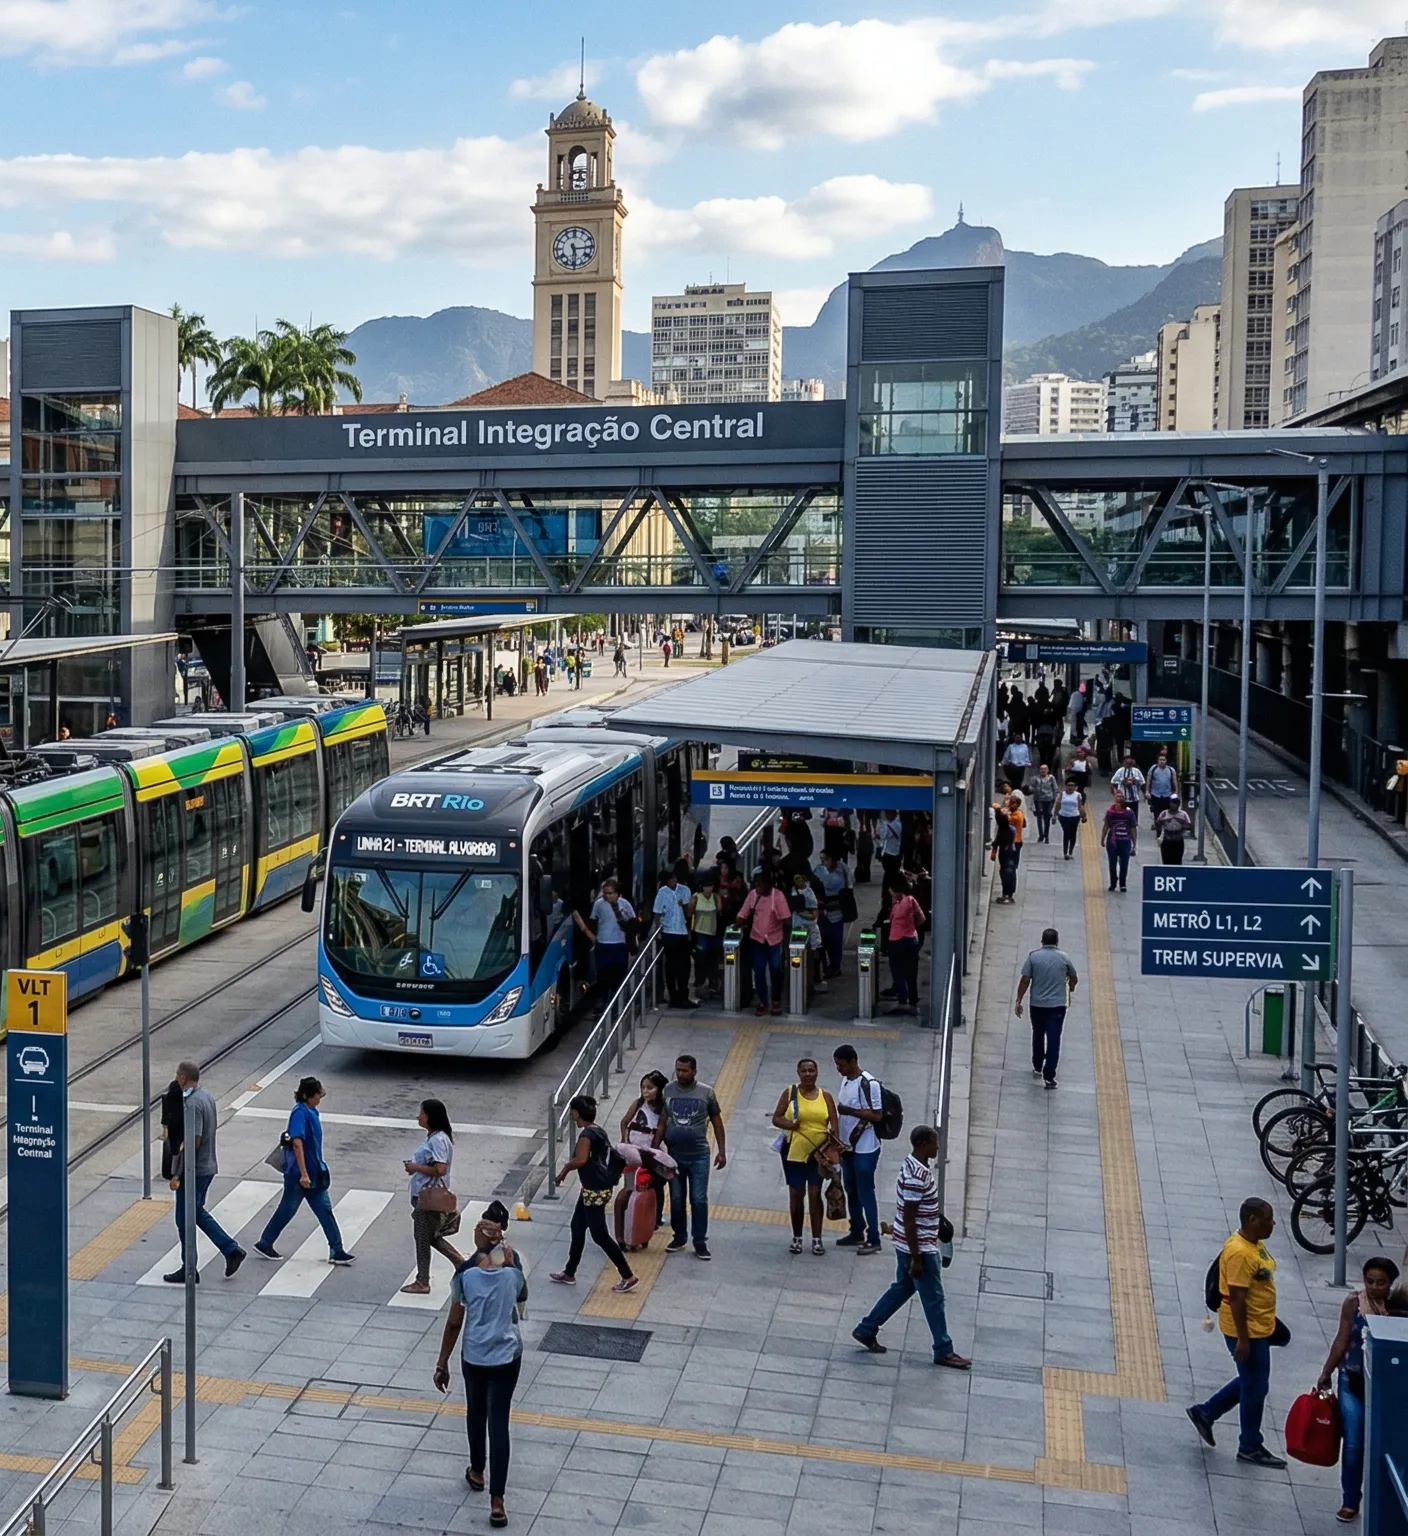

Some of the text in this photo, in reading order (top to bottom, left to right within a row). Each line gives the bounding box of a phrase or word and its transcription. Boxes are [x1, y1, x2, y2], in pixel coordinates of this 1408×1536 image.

[342, 412, 764, 450] Terminal Integração Central
[390, 793, 485, 810] BRT Rio
[384, 838, 394, 852] 21
[1154, 876, 1186, 892] BRT
[1153, 910, 1262, 932] METRÔ L1, L2
[1153, 949, 1283, 968] TREM SUPERVIA
[17, 978, 51, 996] VLT
[28, 1000, 38, 1026] 1
